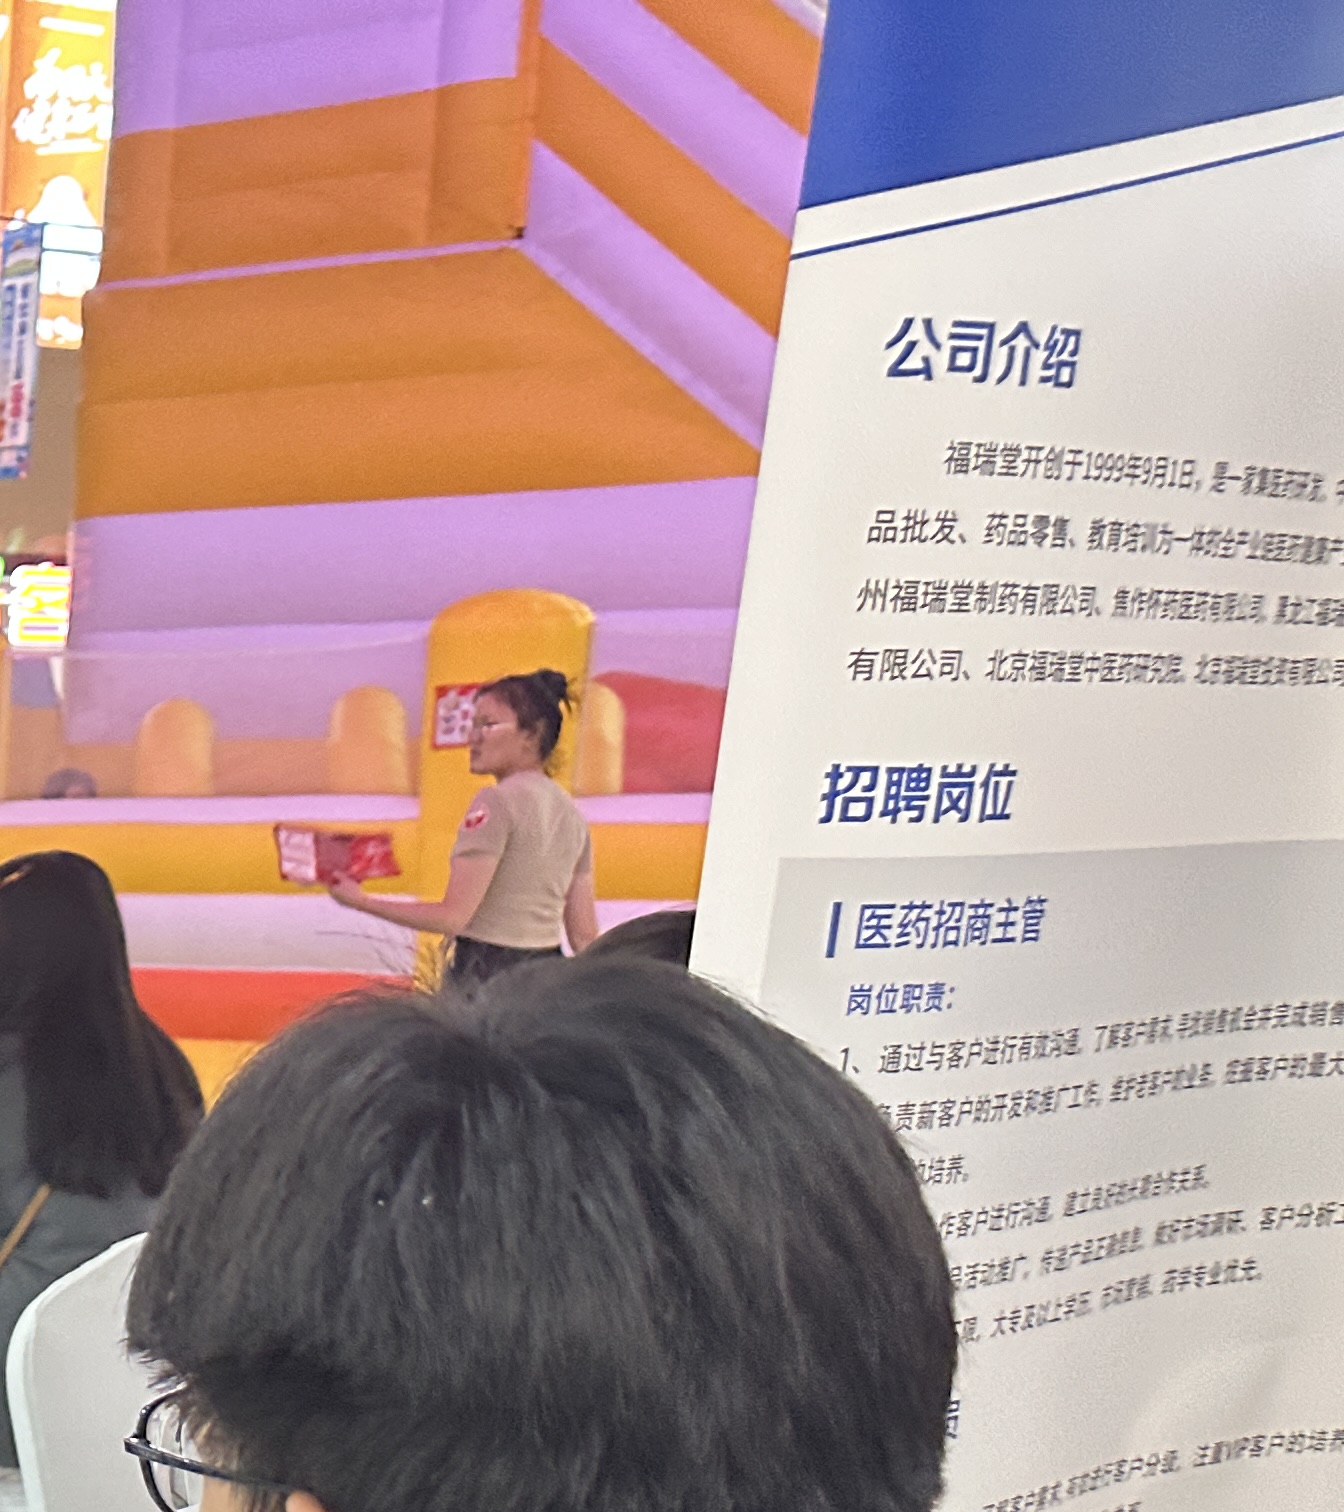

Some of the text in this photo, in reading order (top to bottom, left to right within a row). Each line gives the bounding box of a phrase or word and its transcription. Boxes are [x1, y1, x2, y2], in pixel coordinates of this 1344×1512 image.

[885, 317, 1082, 388] 公司介绍
[819, 763, 1018, 825] 招聘岗位
[854, 896, 1049, 950] 医药招商主管
